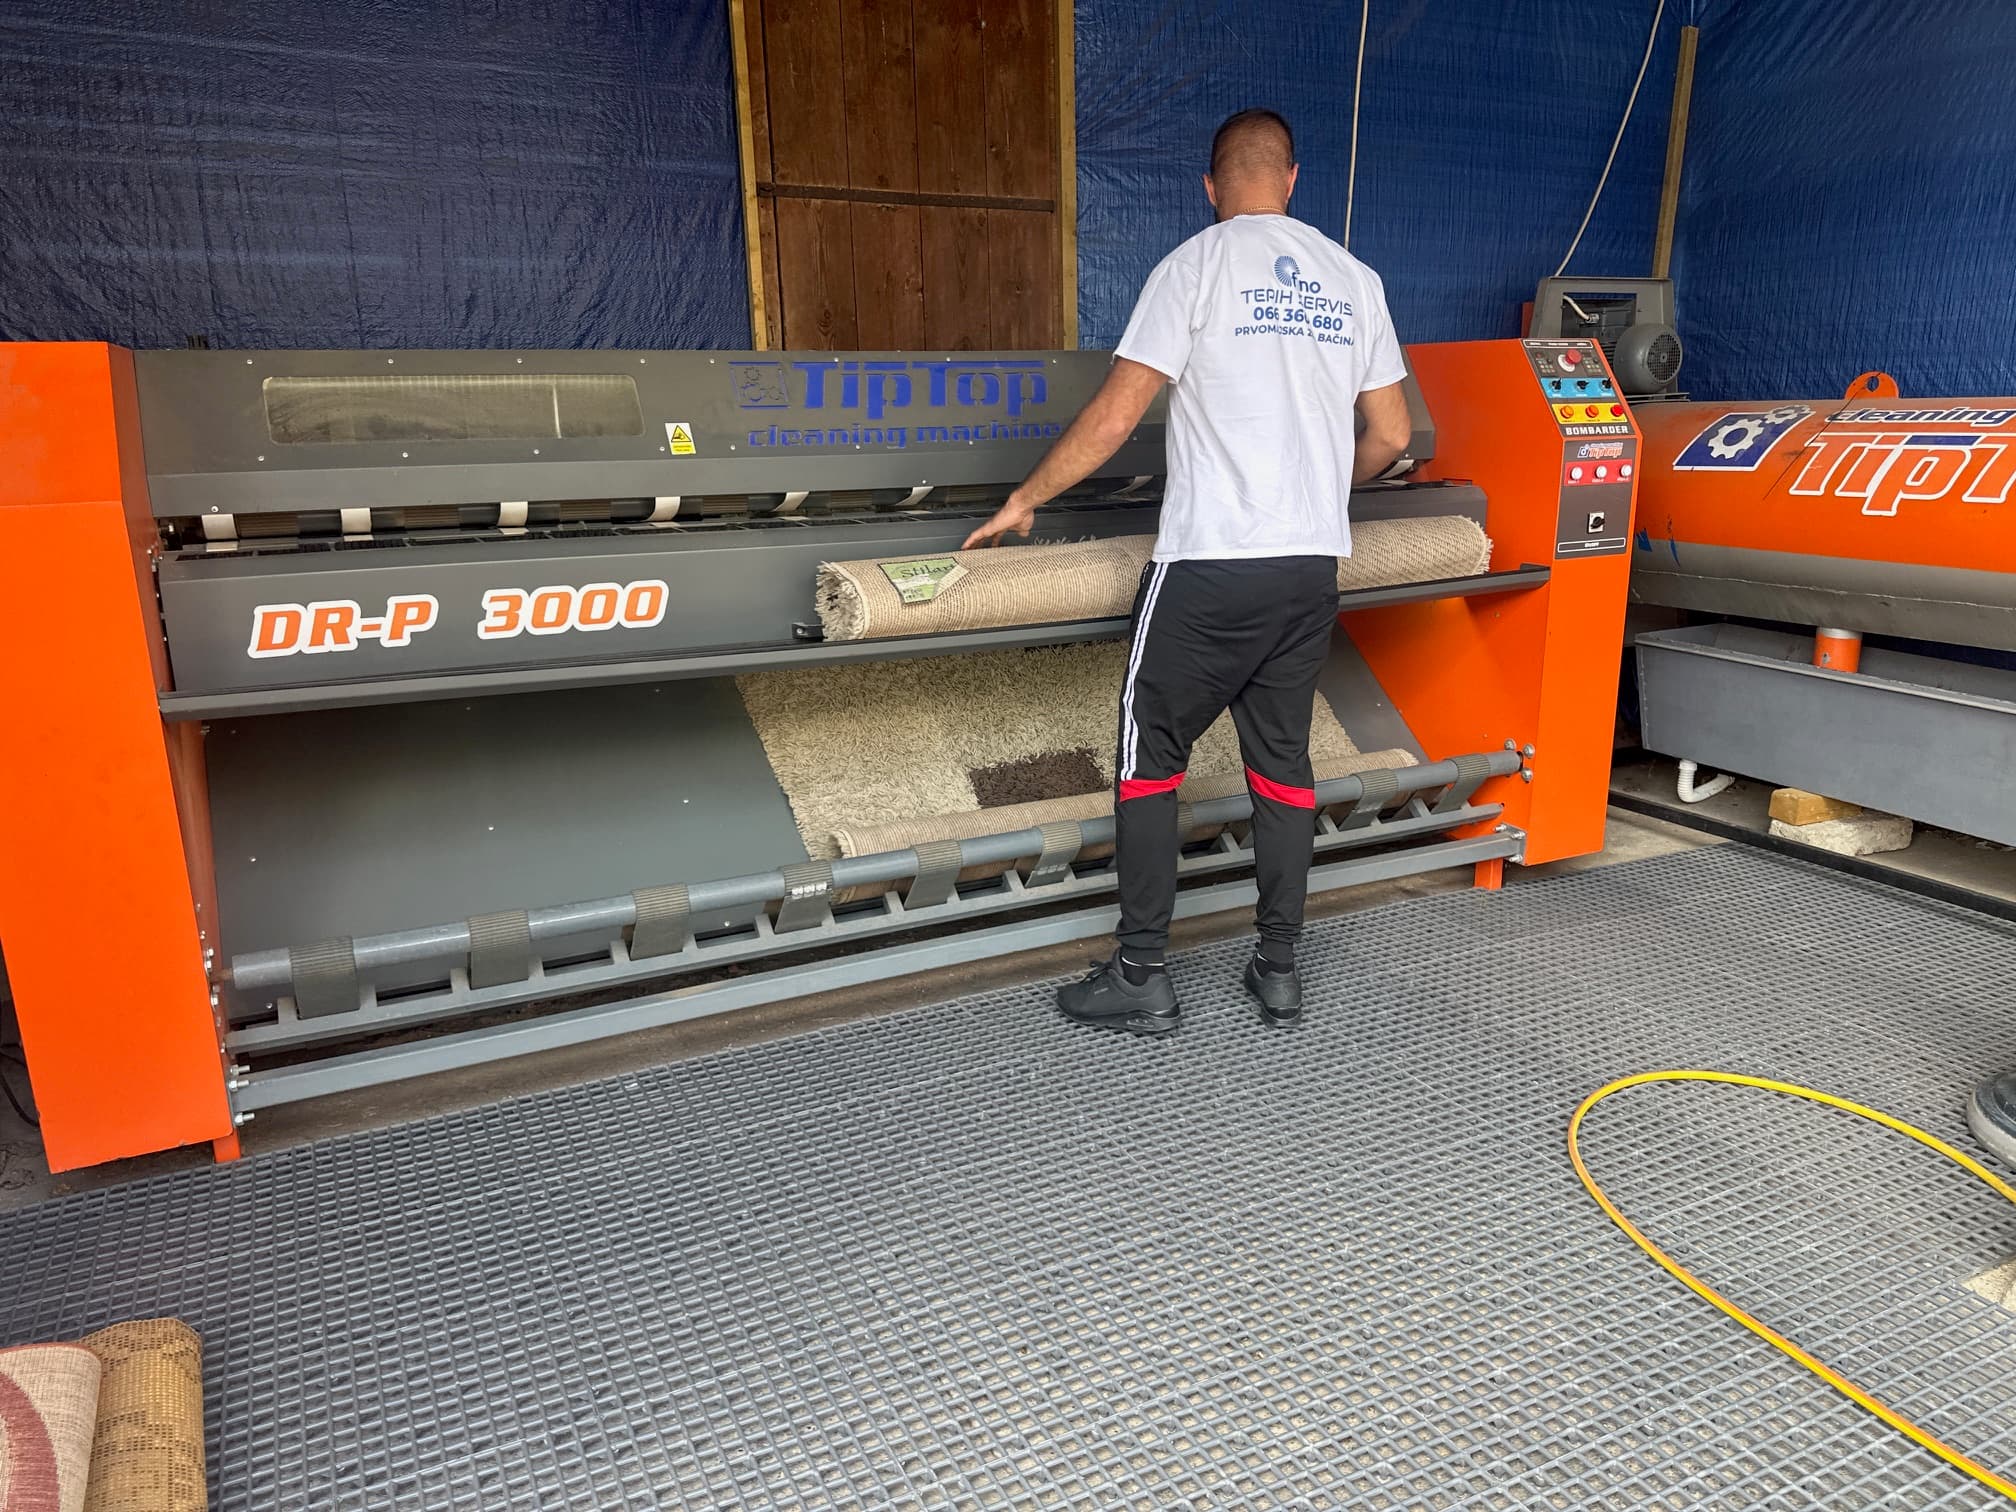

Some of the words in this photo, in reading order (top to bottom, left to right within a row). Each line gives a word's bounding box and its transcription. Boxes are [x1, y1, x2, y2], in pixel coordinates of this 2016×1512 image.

[1312, 315, 1343, 331] 680
[791, 359, 1048, 420] TipTop
[1825, 406, 2016, 427] cleaning
[748, 424, 908, 449] cleaning
[1565, 425, 1629, 436] BOMBARDER
[248, 594, 440, 659] DR-P
[477, 579, 669, 640] 3000
